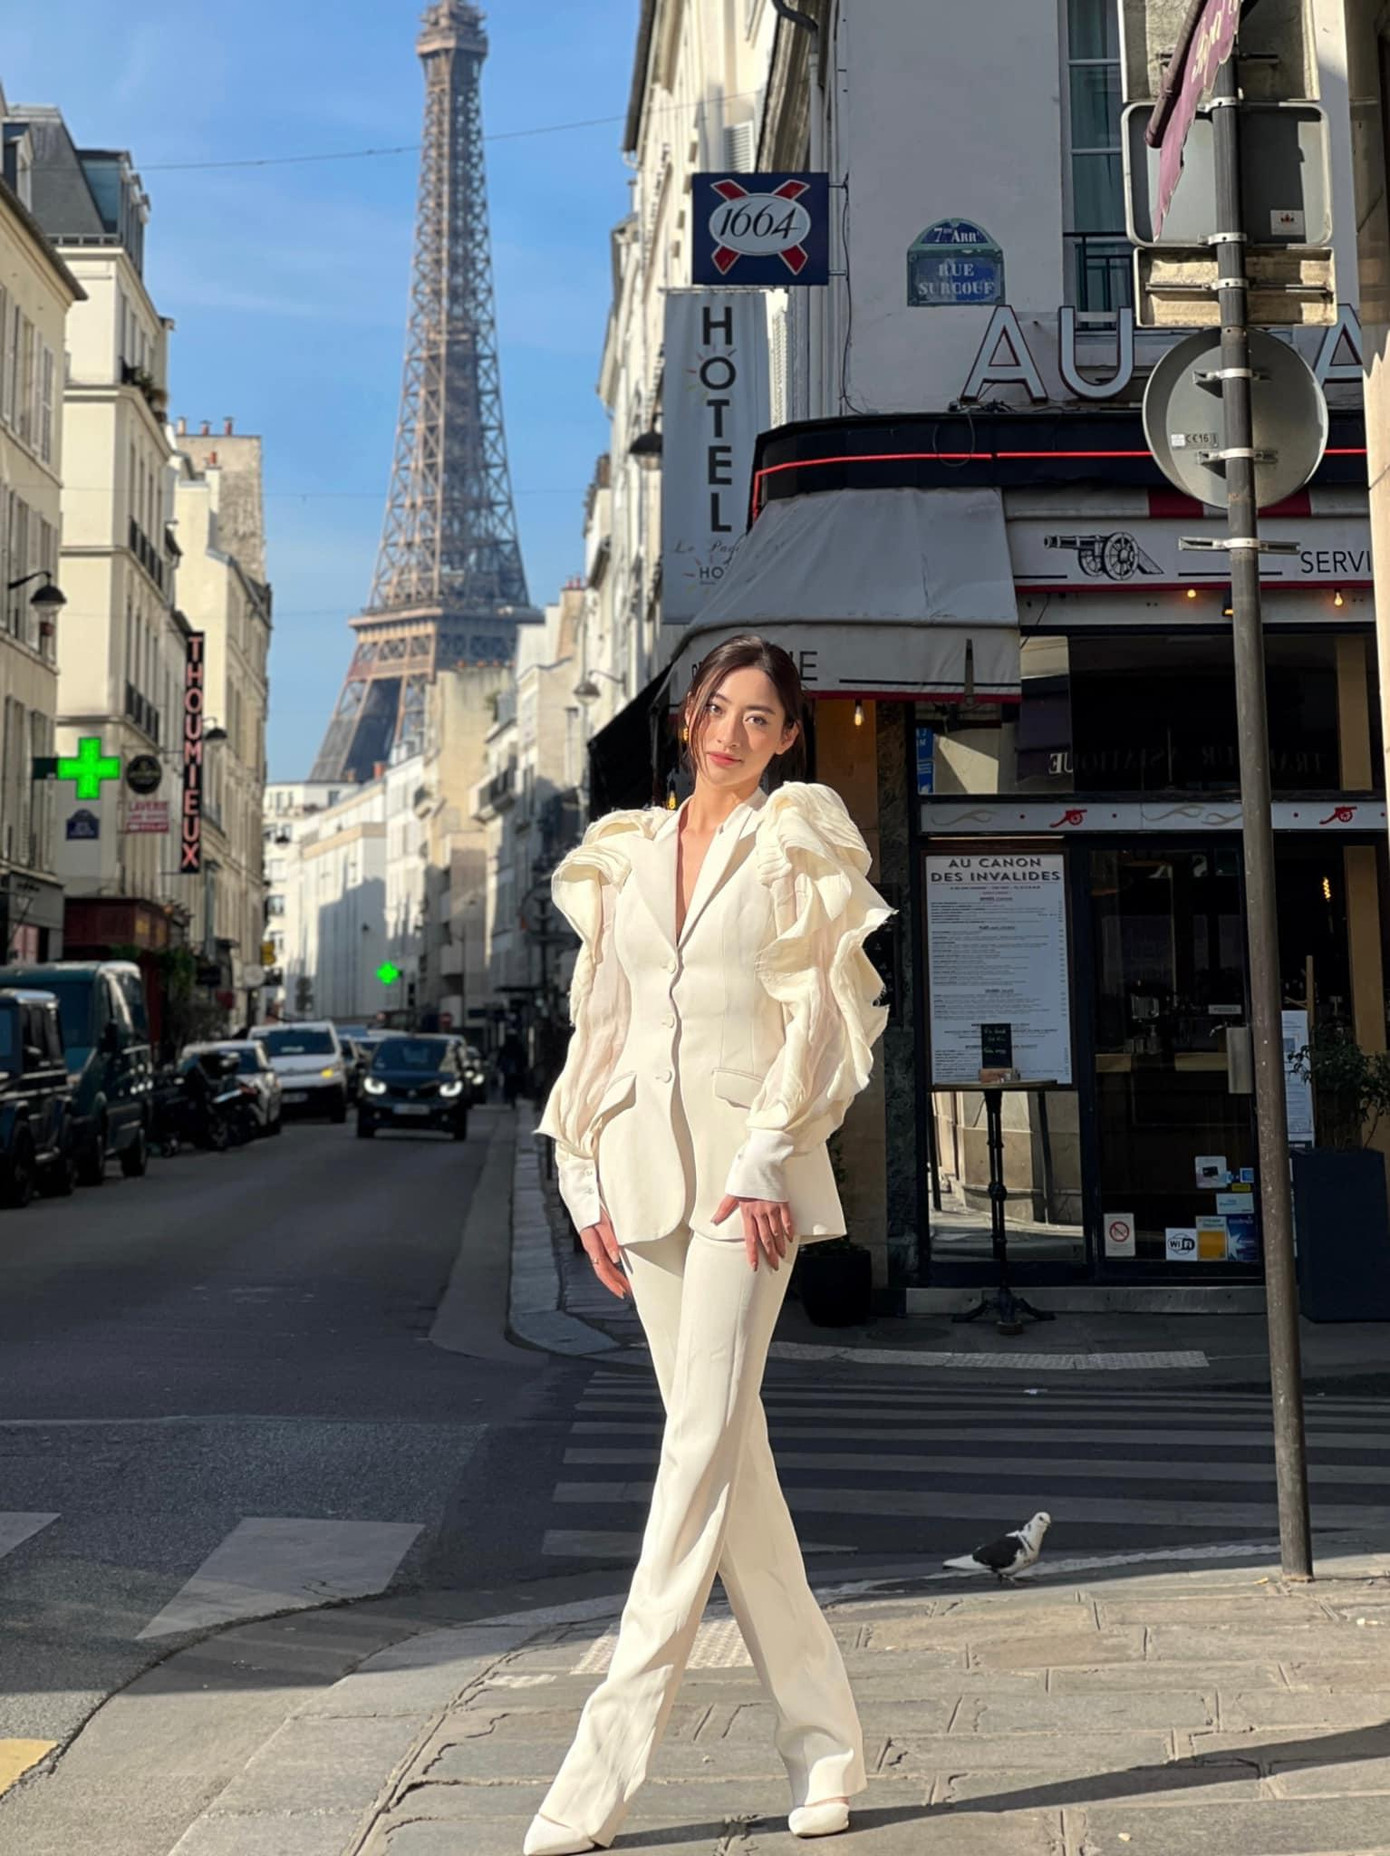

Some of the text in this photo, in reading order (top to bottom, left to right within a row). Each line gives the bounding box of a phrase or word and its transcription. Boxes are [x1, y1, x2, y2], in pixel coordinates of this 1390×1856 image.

[719, 203, 801, 239] 1664
[938, 263, 974, 277] RUE
[918, 281, 995, 295] SURCOUF
[960, 304, 1135, 399] AU
[700, 306, 737, 532] HOTEL
[182, 636, 204, 867] THOUMIEUX
[948, 857, 1042, 868] AU CANON
[931, 871, 1061, 882] DES INVALIDES
